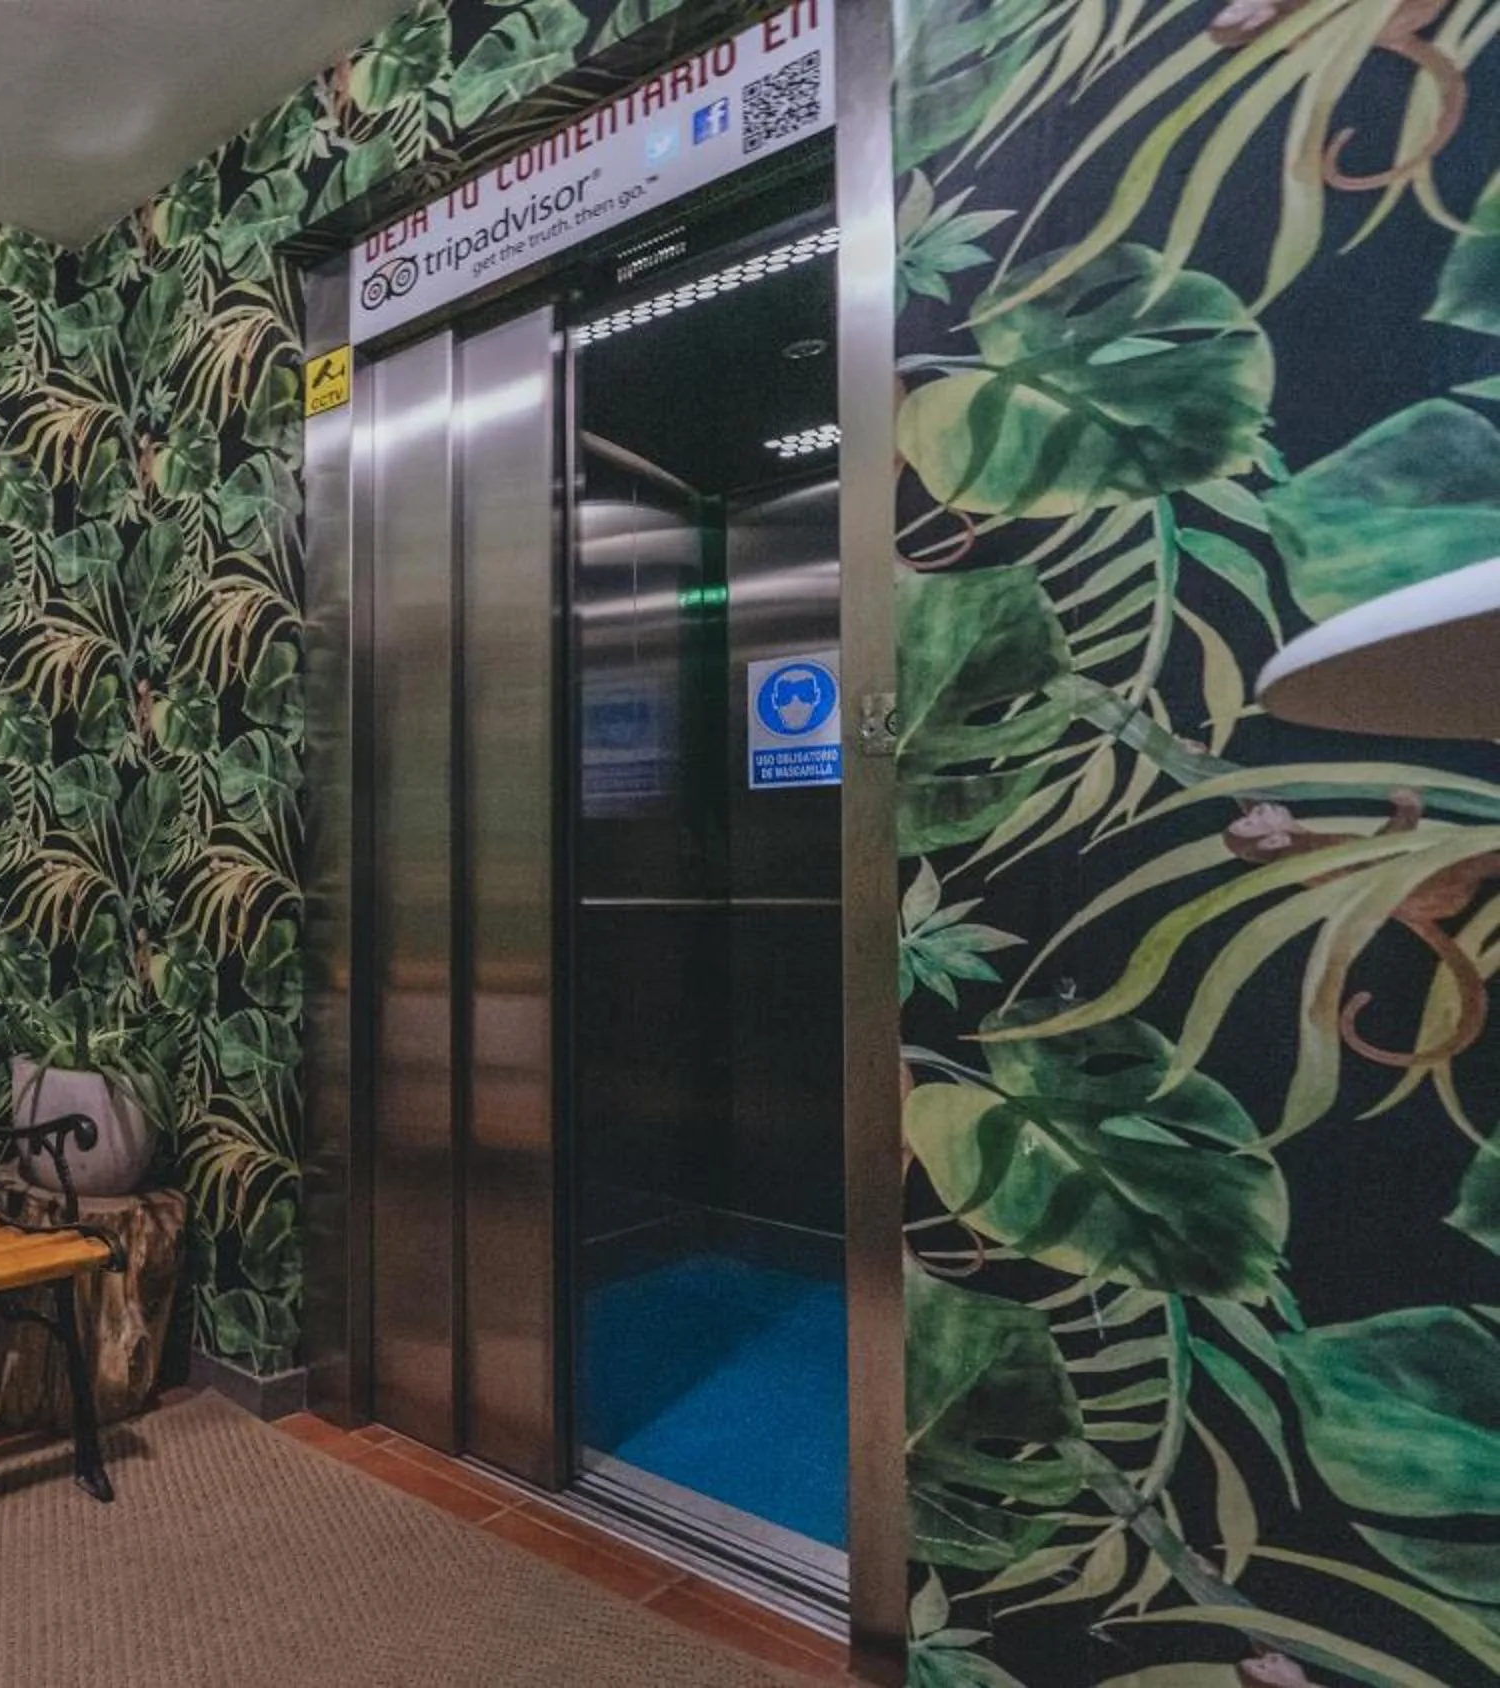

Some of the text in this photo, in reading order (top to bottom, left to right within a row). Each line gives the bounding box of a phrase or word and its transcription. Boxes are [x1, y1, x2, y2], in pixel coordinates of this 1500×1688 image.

[365, 205, 429, 262] DEJA
[496, 37, 737, 191] COMENTARIO
[763, 0, 818, 53] EN
[473, 253, 497, 277] get
[499, 240, 526, 261] the
[573, 198, 615, 226] then
[310, 387, 344, 410] CCTV
